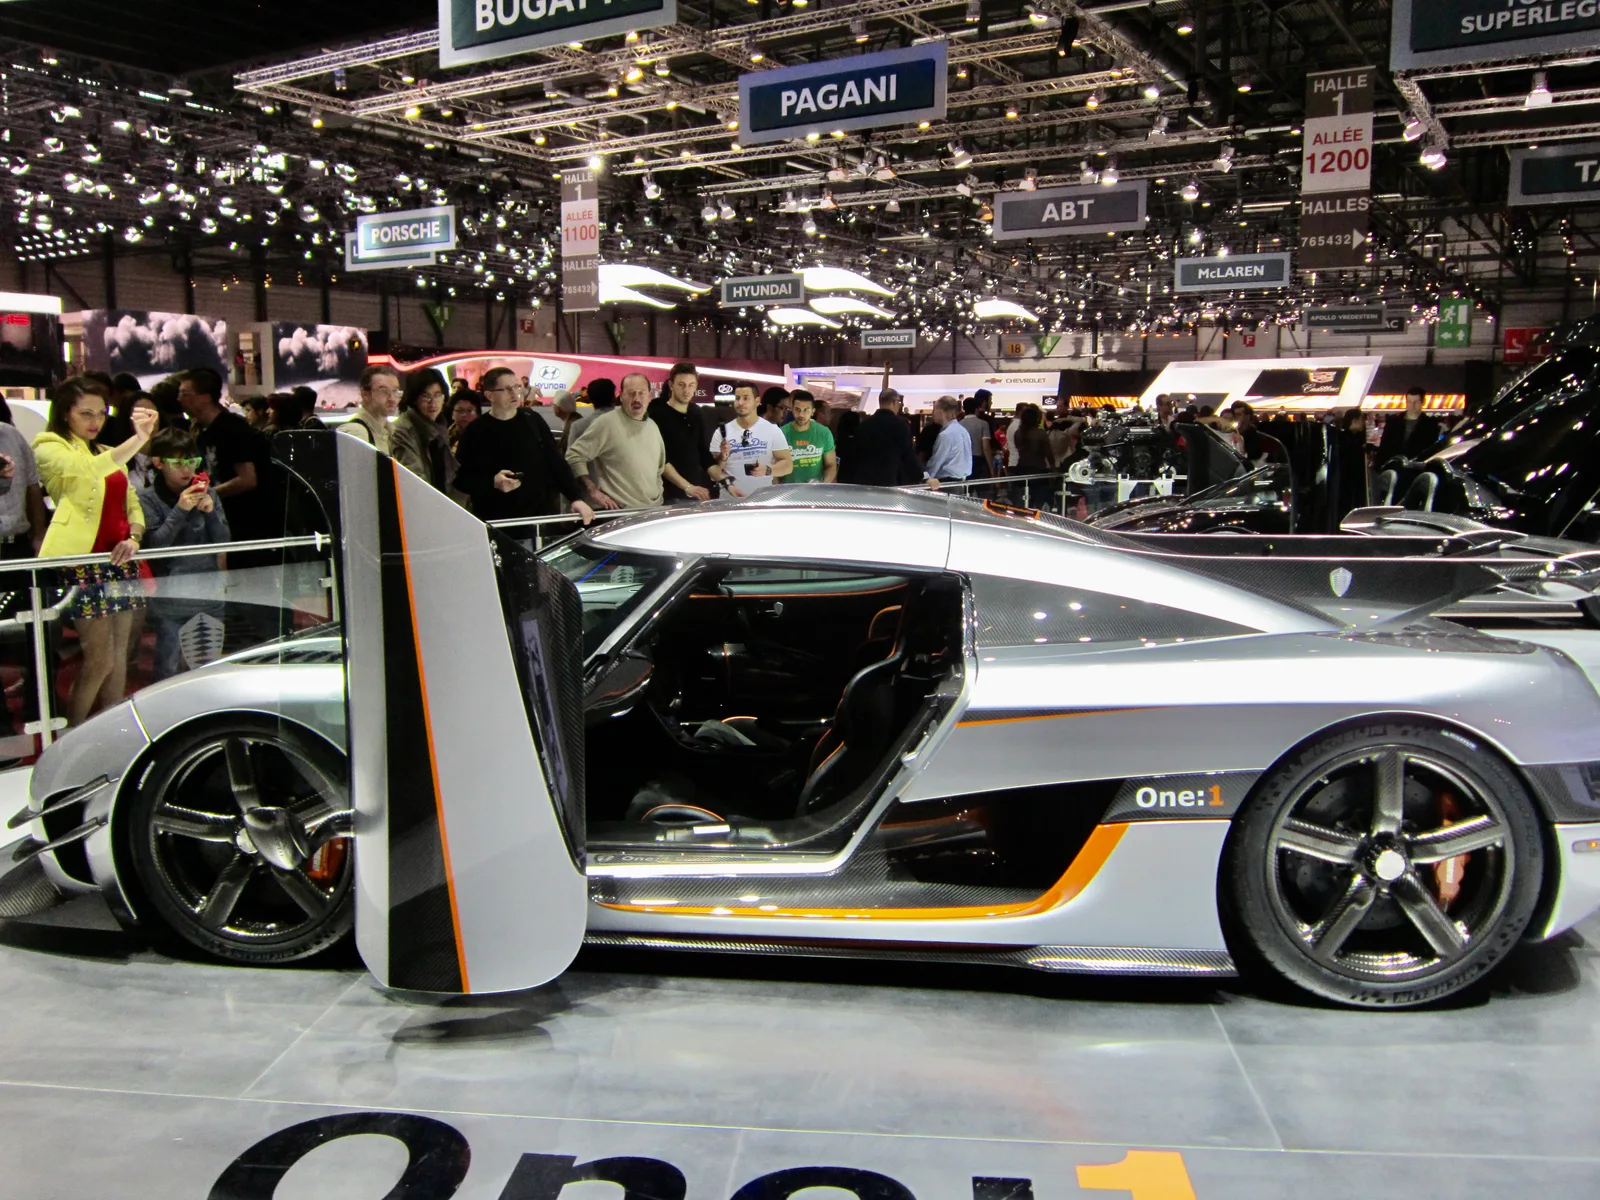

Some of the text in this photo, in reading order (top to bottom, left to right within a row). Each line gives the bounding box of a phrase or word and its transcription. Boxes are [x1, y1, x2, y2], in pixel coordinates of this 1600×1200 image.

[1460, 0, 1600, 34] SUPERLEG
[1313, 74, 1368, 93] HALLE
[781, 74, 897, 117] PAGANI
[1332, 92, 1344, 116] 1
[1312, 127, 1363, 146] ALLÉE
[1305, 148, 1369, 174] 1200
[564, 172, 594, 185] HALLE
[574, 184, 582, 201] 1
[1041, 199, 1095, 223] ABT
[1301, 197, 1369, 216] HALLES
[371, 221, 441, 244] PORSCHE
[563, 224, 597, 242] 1100
[1301, 234, 1352, 247] 765432
[562, 259, 598, 272] HALLES
[1198, 265, 1265, 279] McLAREN
[733, 283, 792, 298] HYUNDAI
[867, 335, 910, 343] CHEVROLET
[1010, 344, 1021, 354] 18
[1135, 784, 1224, 808] One:1
